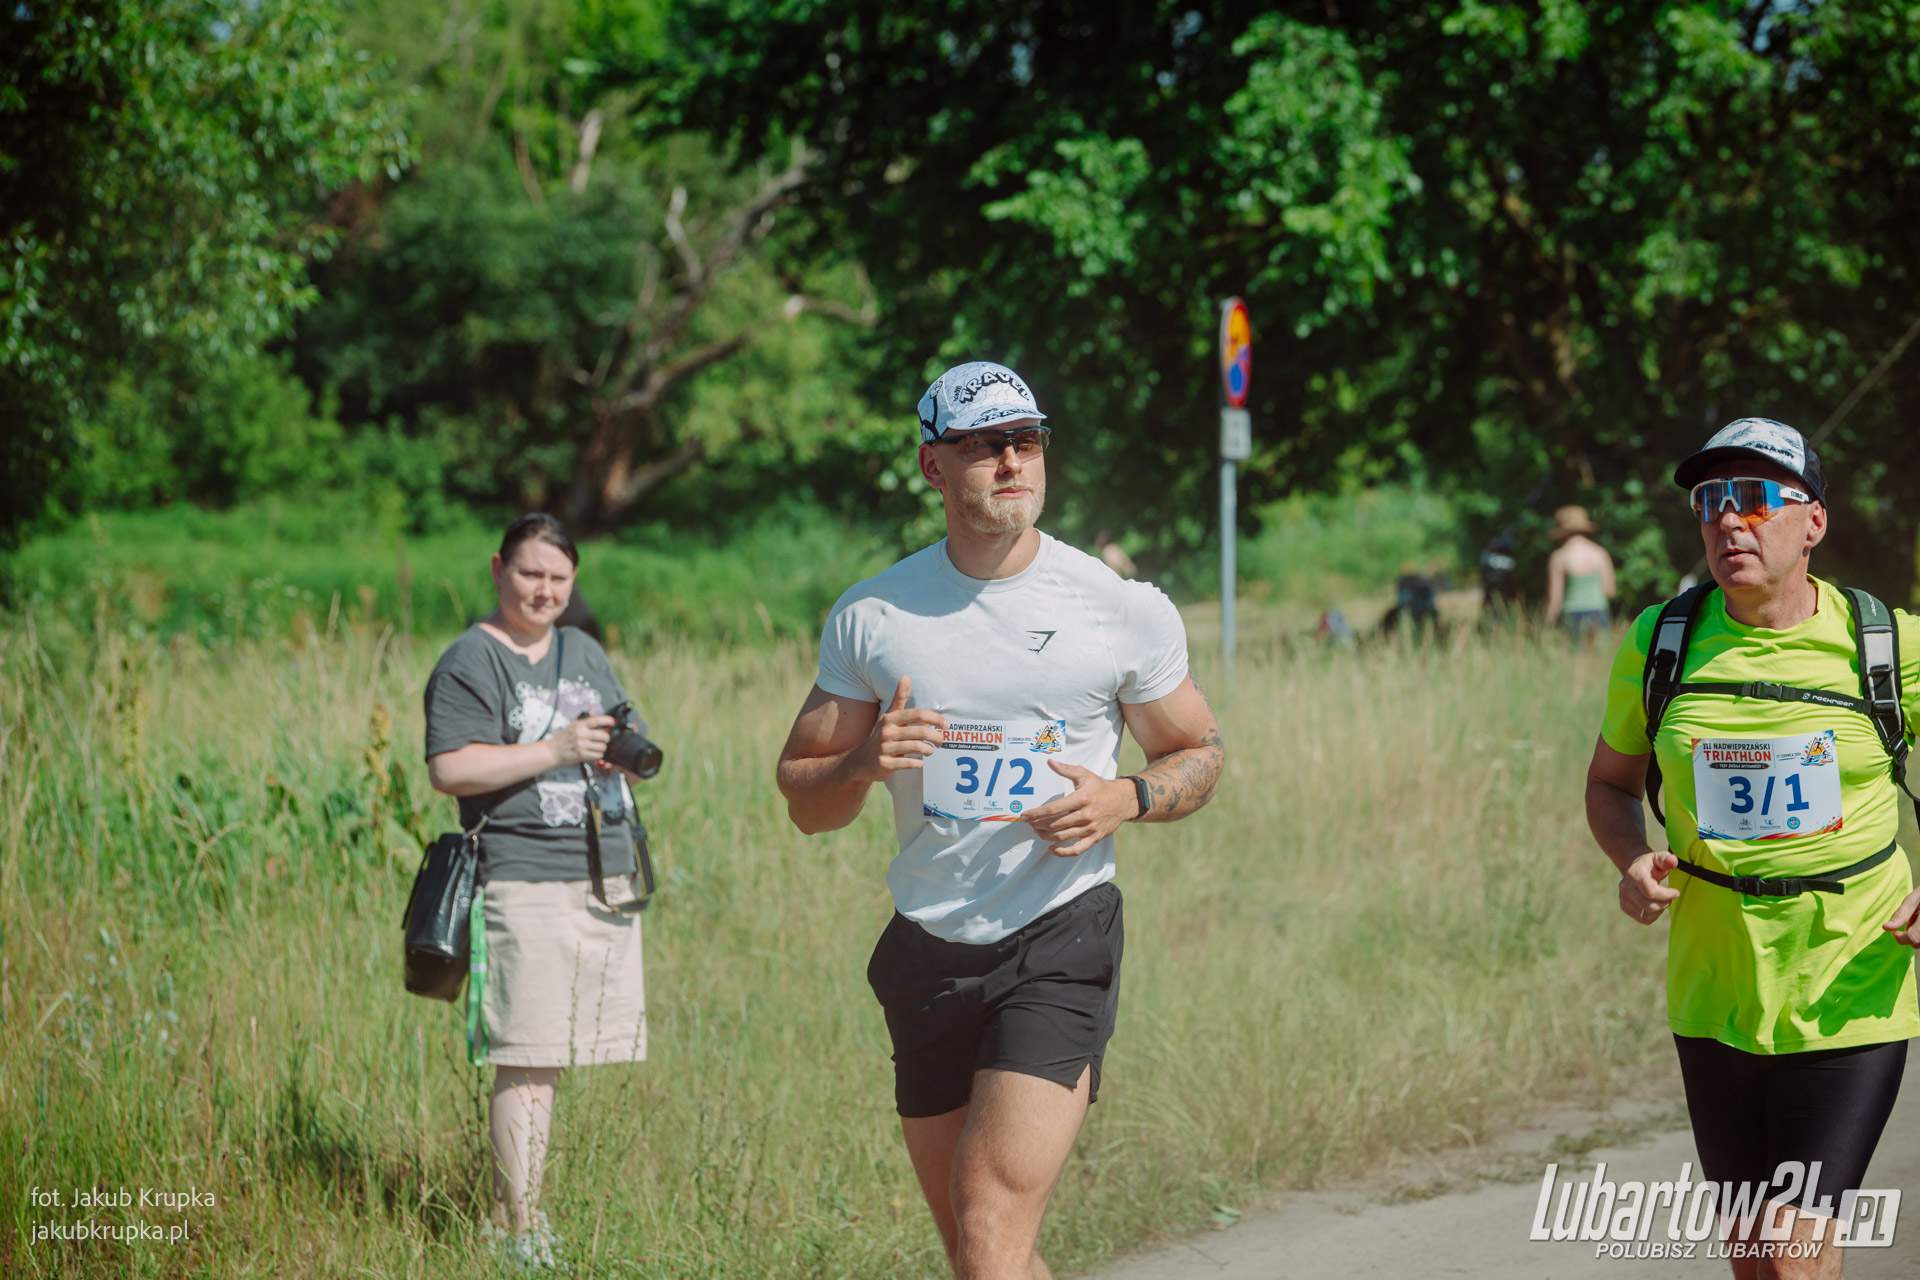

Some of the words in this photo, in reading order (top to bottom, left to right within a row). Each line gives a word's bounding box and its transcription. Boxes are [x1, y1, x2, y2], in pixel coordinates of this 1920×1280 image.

[949, 722, 1003, 732] ADWIEPRZAŃSKI
[941, 730, 1003, 743] RIATHLON
[1713, 742, 1770, 750] NADWIEPRZAŃSKI
[1704, 750, 1771, 762] TRIATHLON
[955, 756, 1034, 796] 3/2
[1728, 773, 1809, 815] 3/1
